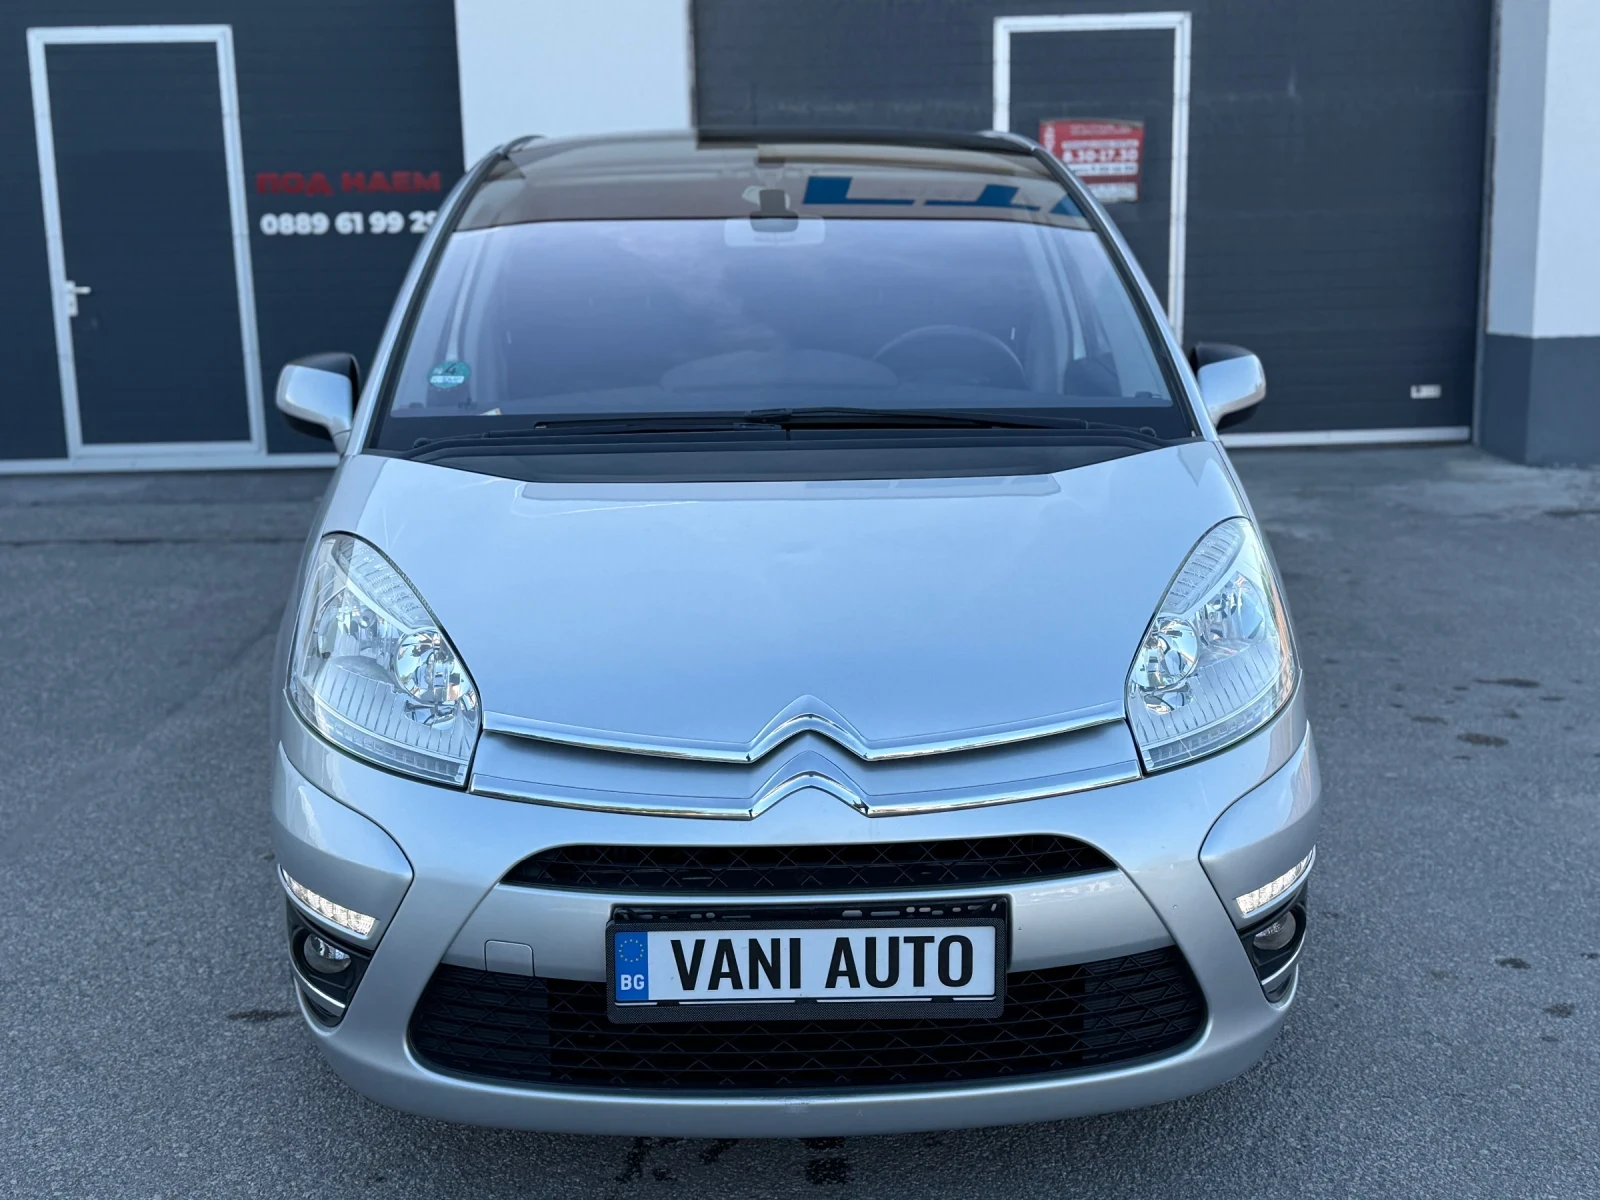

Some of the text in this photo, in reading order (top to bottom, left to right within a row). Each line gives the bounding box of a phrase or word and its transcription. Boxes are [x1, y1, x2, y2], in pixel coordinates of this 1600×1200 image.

[256, 171, 441, 196] ПОД НАЕМ
[259, 212, 330, 236] 0889
[334, 211, 364, 235] 61
[369, 211, 405, 234] 99
[671, 935, 973, 991] VANI AUTO
[620, 974, 645, 991] BG
